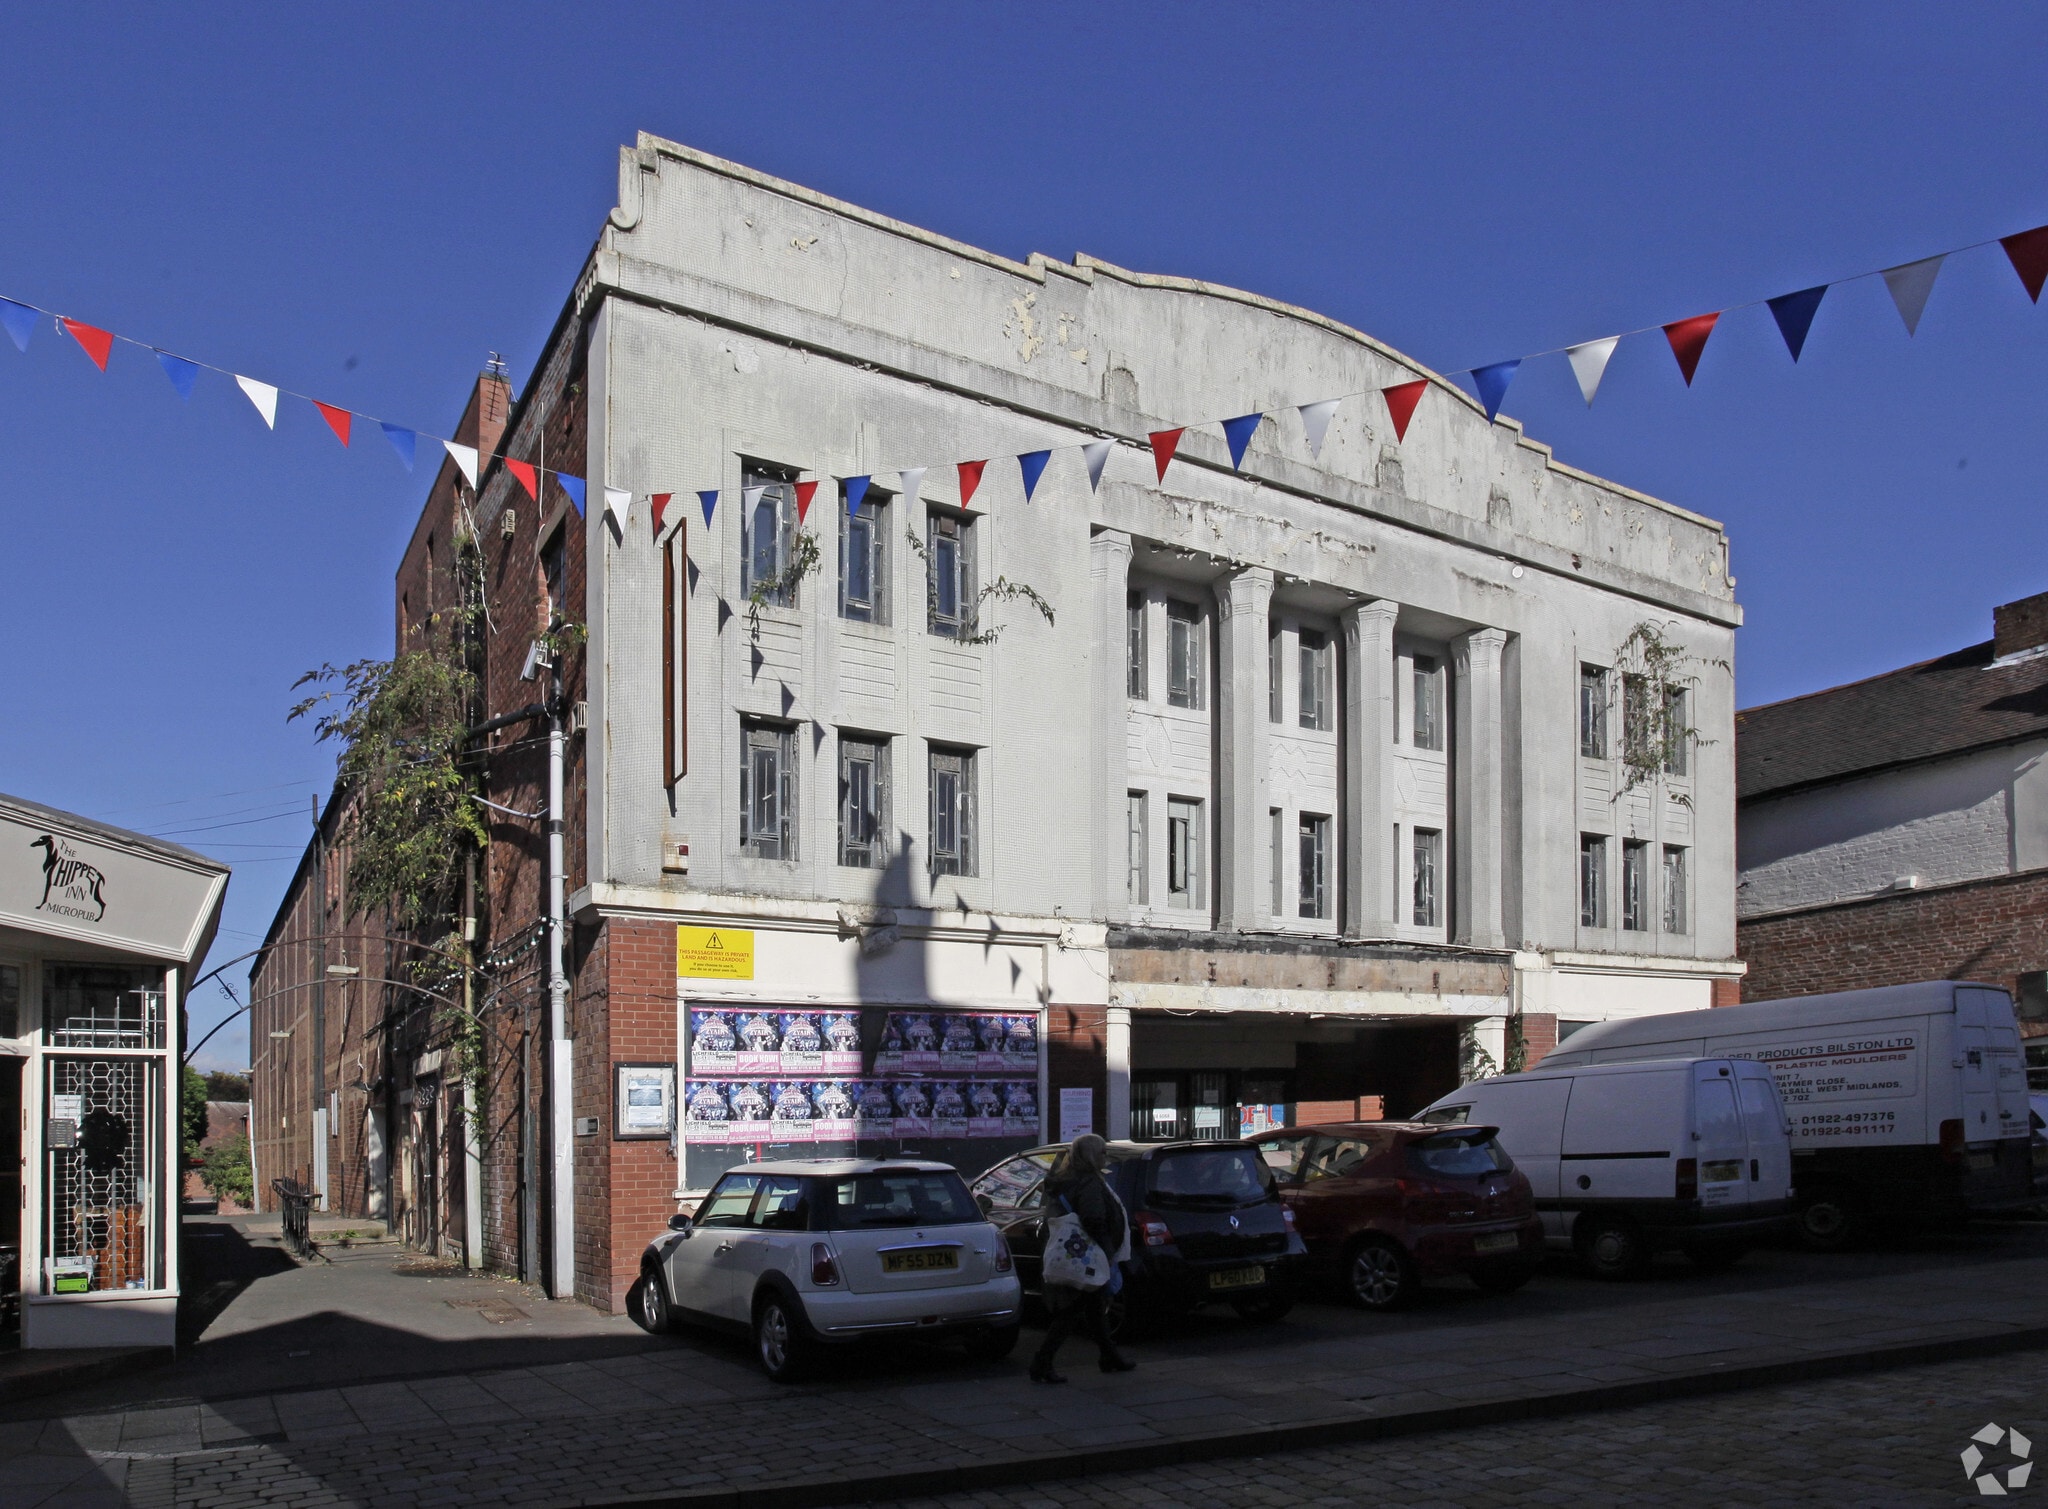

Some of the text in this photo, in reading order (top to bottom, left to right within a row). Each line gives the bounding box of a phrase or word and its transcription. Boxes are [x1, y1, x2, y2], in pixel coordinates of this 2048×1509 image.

[60, 839, 78, 857] THE
[65, 885, 87, 902] INN
[46, 903, 96, 921] MICROPUB
[1757, 1046, 1823, 1060] PRODUCTS
[1827, 1040, 1883, 1053] BILSTON
[1887, 1037, 1914, 1048] LTD
[739, 1054, 758, 1063] BOOK
[1776, 1053, 1907, 1070] PLASTIC MOULDERS
[1775, 1079, 1812, 1088] EAYMER
[1817, 1084, 1845, 1093] WEST
[1793, 1094, 1810, 1102] 7QZ
[1788, 1111, 1895, 1125] L: 01922-497376
[730, 1124, 749, 1133] BOOK
[815, 1122, 833, 1131] BOOK
[1802, 1124, 1895, 1137] 01922-491117
